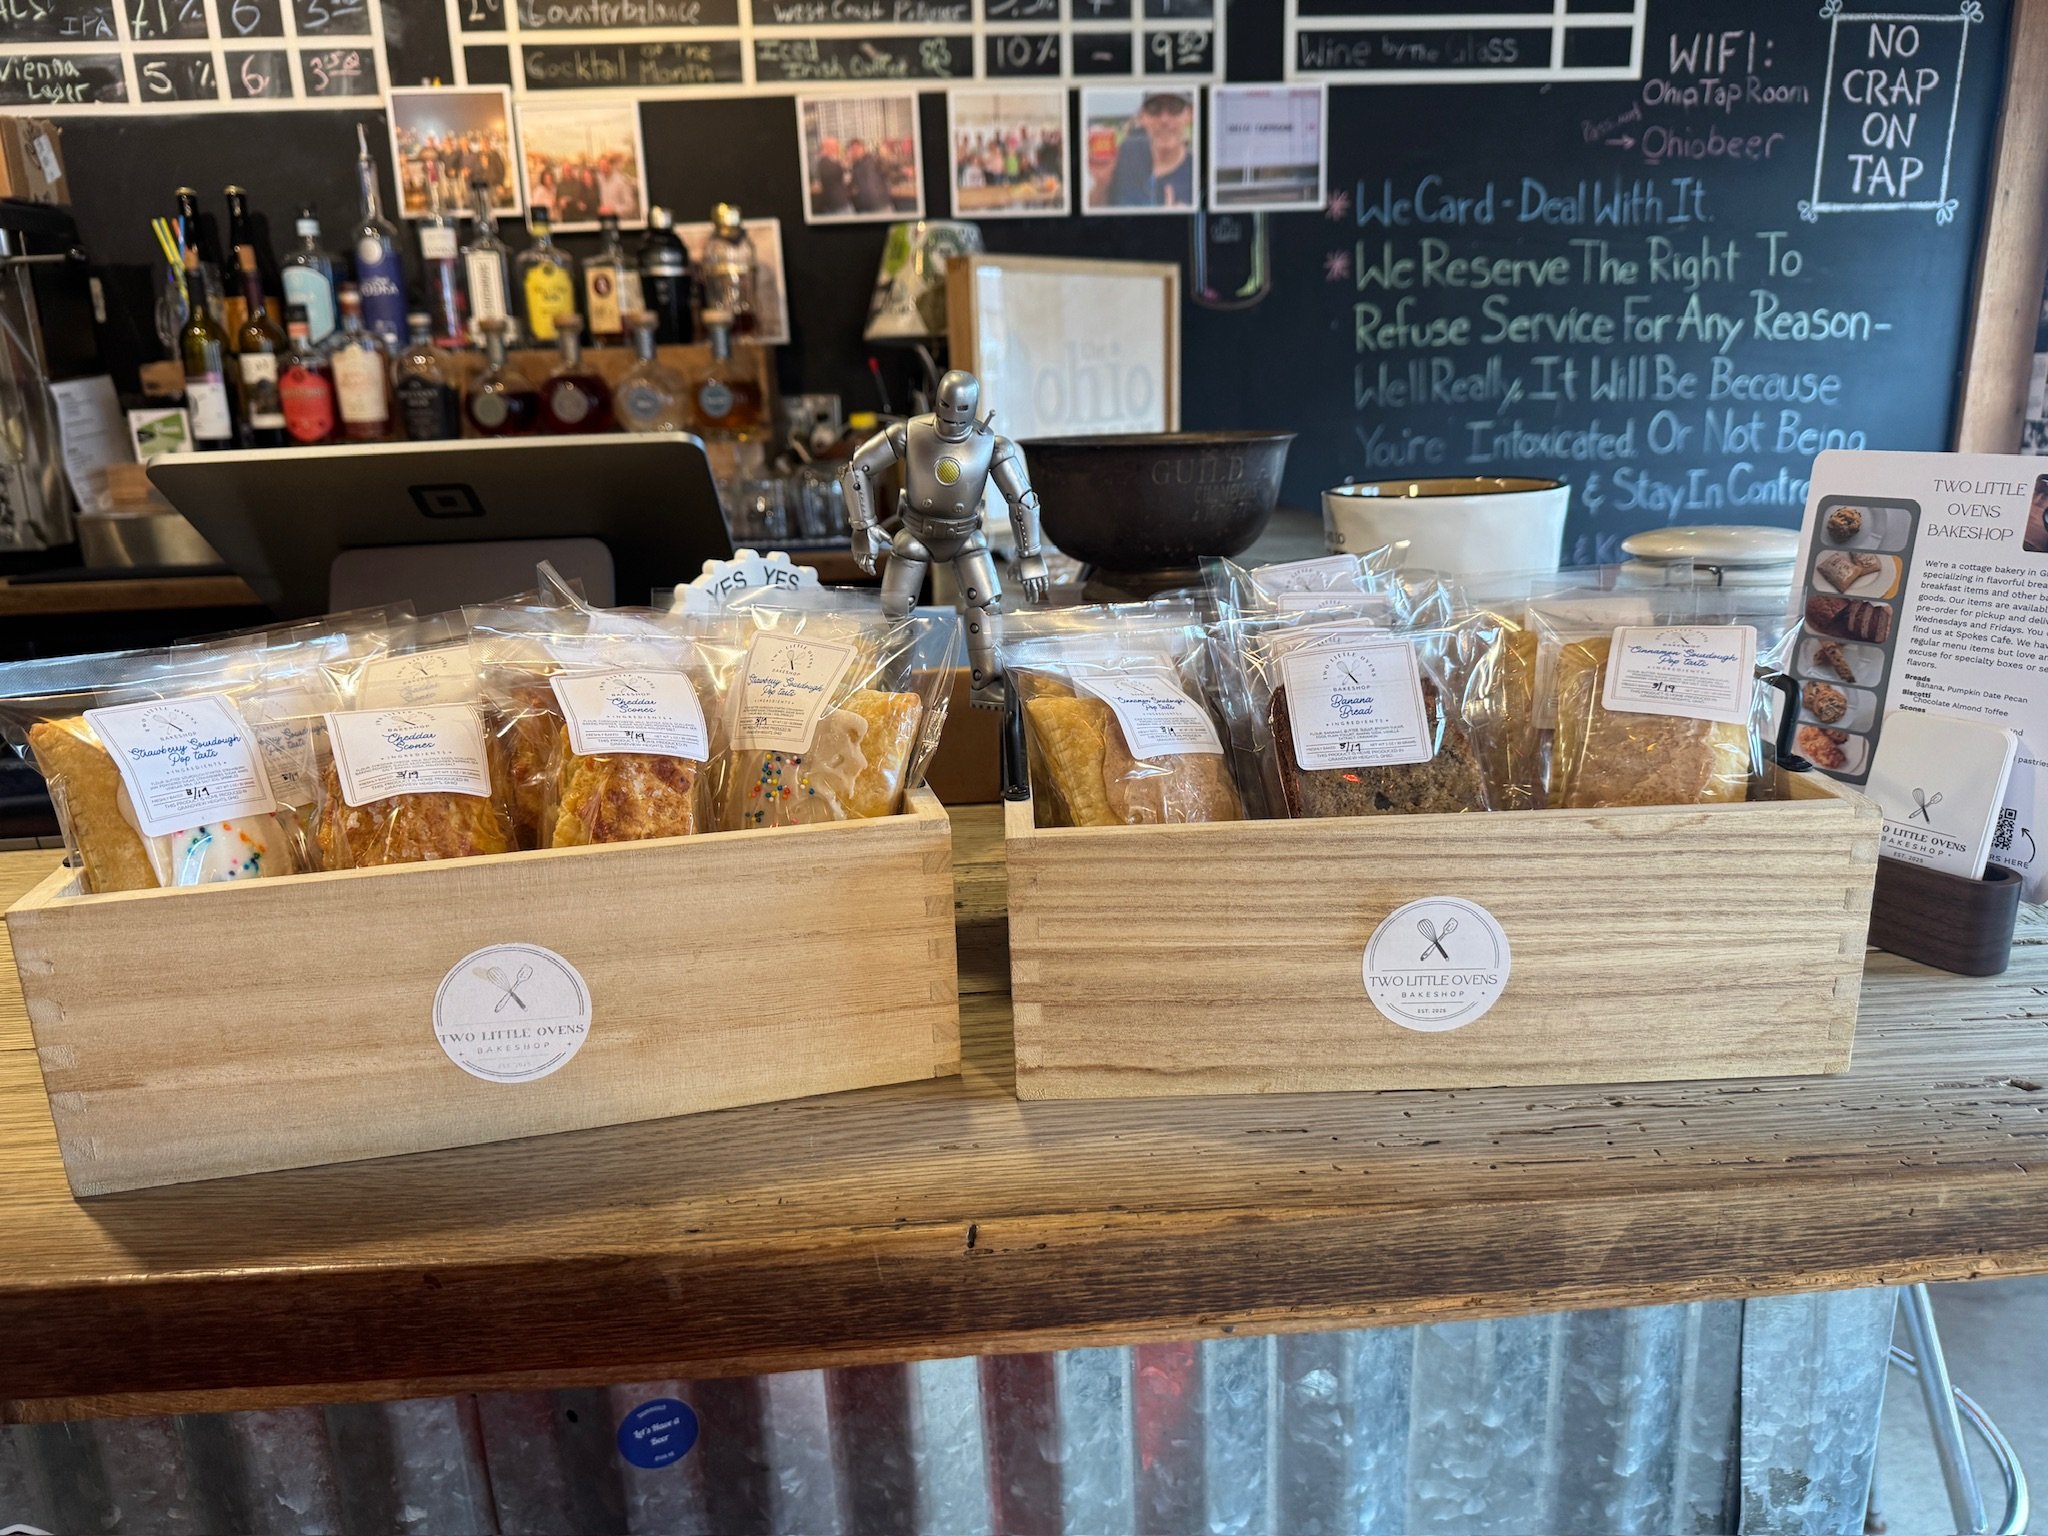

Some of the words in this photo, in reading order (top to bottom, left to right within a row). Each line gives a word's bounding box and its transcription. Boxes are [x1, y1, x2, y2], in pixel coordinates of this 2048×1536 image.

[1301, 34, 1371, 67] Wine
[1868, 24, 1919, 59] NO
[1669, 30, 1774, 74] WIFI:
[27, 82, 91, 105] Lager
[1842, 69, 1938, 106] CRAP
[1862, 113, 1917, 149] ON
[1641, 126, 1784, 160] Ohiobeer
[1847, 153, 1923, 198] TAP
[1356, 179, 1412, 227] We
[1414, 174, 1495, 225] Card
[1516, 176, 1587, 224] Deal
[1594, 175, 1663, 226] With
[1356, 239, 1415, 290] We
[1419, 237, 1570, 288] Reserve
[1569, 238, 1639, 285] The
[1646, 234, 1741, 293] Right
[1755, 231, 1803, 277] To
[1353, 295, 1471, 353] Refuse
[1481, 294, 1615, 343] Service
[1623, 295, 1673, 343] For
[1676, 291, 1745, 354] Any
[1527, 355, 1579, 401] It
[1591, 355, 1648, 402] Will
[1654, 353, 1698, 400] Be
[1709, 355, 1843, 406] Because
[1355, 424, 1447, 469] You're
[1464, 407, 1637, 464] Intoxicated
[1647, 408, 1695, 454] Or
[1703, 406, 1767, 454] Not
[1776, 408, 1867, 456] Being
[1612, 466, 1685, 523] Stay
[1685, 467, 1726, 510] In
[1933, 479, 1972, 494] TWO
[1975, 481, 2028, 497] LITTLE
[1947, 503, 2001, 519] OVENS
[1927, 523, 2014, 542] BAKESHOP
[1925, 560, 1949, 569] We're
[1959, 563, 1992, 573] cottage
[1994, 565, 2026, 577] bakery
[2027, 568, 2037, 576] in
[762, 566, 800, 592] YES
[1922, 571, 1973, 583] specializing
[1975, 575, 1984, 583] in
[1986, 576, 2025, 587] flavorful
[1920, 581, 1961, 593] breakfast
[1963, 585, 1989, 596] items
[1991, 589, 2009, 598] and
[2011, 591, 2037, 601] other
[1918, 594, 1946, 603] goods.
[1948, 596, 1966, 604] Our
[1967, 598, 1993, 608] items
[1995, 601, 2010, 610] are
[1916, 604, 1958, 616] pre-order
[1960, 608, 1973, 617] for
[1975, 610, 2006, 621] pickup
[2008, 615, 2026, 623] and
[1914, 614, 1968, 629] Wednesdays
[1970, 621, 1988, 630] and
[1989, 623, 2025, 636] Fridays.
[2027, 627, 2044, 636] You
[1912, 625, 1930, 634] find
[1944, 629, 1954, 637] at
[1956, 630, 1988, 642] Spokes
[1990, 635, 2014, 645] Cafe.
[2016, 638, 2031, 648] We
[1628, 645, 1681, 656] Cinnamon
[1683, 649, 1739, 662] Sourdough
[1910, 637, 1941, 647] regular
[1942, 641, 1967, 651] menu
[1969, 644, 1995, 655] items
[1997, 647, 2014, 657] but
[2016, 649, 2036, 660] love
[1658, 656, 1680, 667] Pop
[1906, 658, 1937, 669] flavors.
[1908, 648, 1938, 658] excuse
[1939, 651, 1952, 660] for
[1954, 654, 1994, 667] specialty
[1996, 659, 2023, 670] boxes
[2026, 663, 2036, 671] or
[1904, 673, 1931, 683] Breads
[760, 685, 776, 698] Pop
[1331, 694, 1374, 708] Banana
[1902, 688, 1932, 699] Biscotti
[1915, 681, 1945, 692] Banana,
[1947, 685, 1981, 697] Pumpkin
[1982, 690, 2002, 700] Date
[2003, 694, 2028, 704] Pecan
[606, 697, 657, 709] Cheddar
[619, 704, 657, 714] Scones
[1339, 704, 1374, 719] Bread
[1899, 703, 1926, 714] Scones
[1912, 696, 1950, 708] Chocolate
[1952, 702, 1982, 713] Almond
[1984, 707, 2009, 717] Toffee
[128, 745, 188, 760] Strawberry
[187, 733, 242, 751] Sourdough
[382, 732, 437, 744] Cheddar
[395, 741, 436, 752] Scones
[168, 752, 190, 767] Pop
[1881, 835, 1944, 856] BAKESHOP
[1893, 827, 1928, 843] LITTLE
[1931, 837, 1967, 853] OVENS
[2003, 857, 2029, 870] HERE
[1368, 976, 1404, 987] TWO
[1406, 975, 1449, 986] LITTLE
[1451, 974, 1498, 986] OVENS
[1401, 991, 1466, 999] BAKESHOP
[439, 1033, 475, 1045] TWO
[481, 1029, 531, 1041] LITTLE
[537, 1023, 585, 1037] OVENS
[477, 1041, 550, 1055] BAKESHOP
